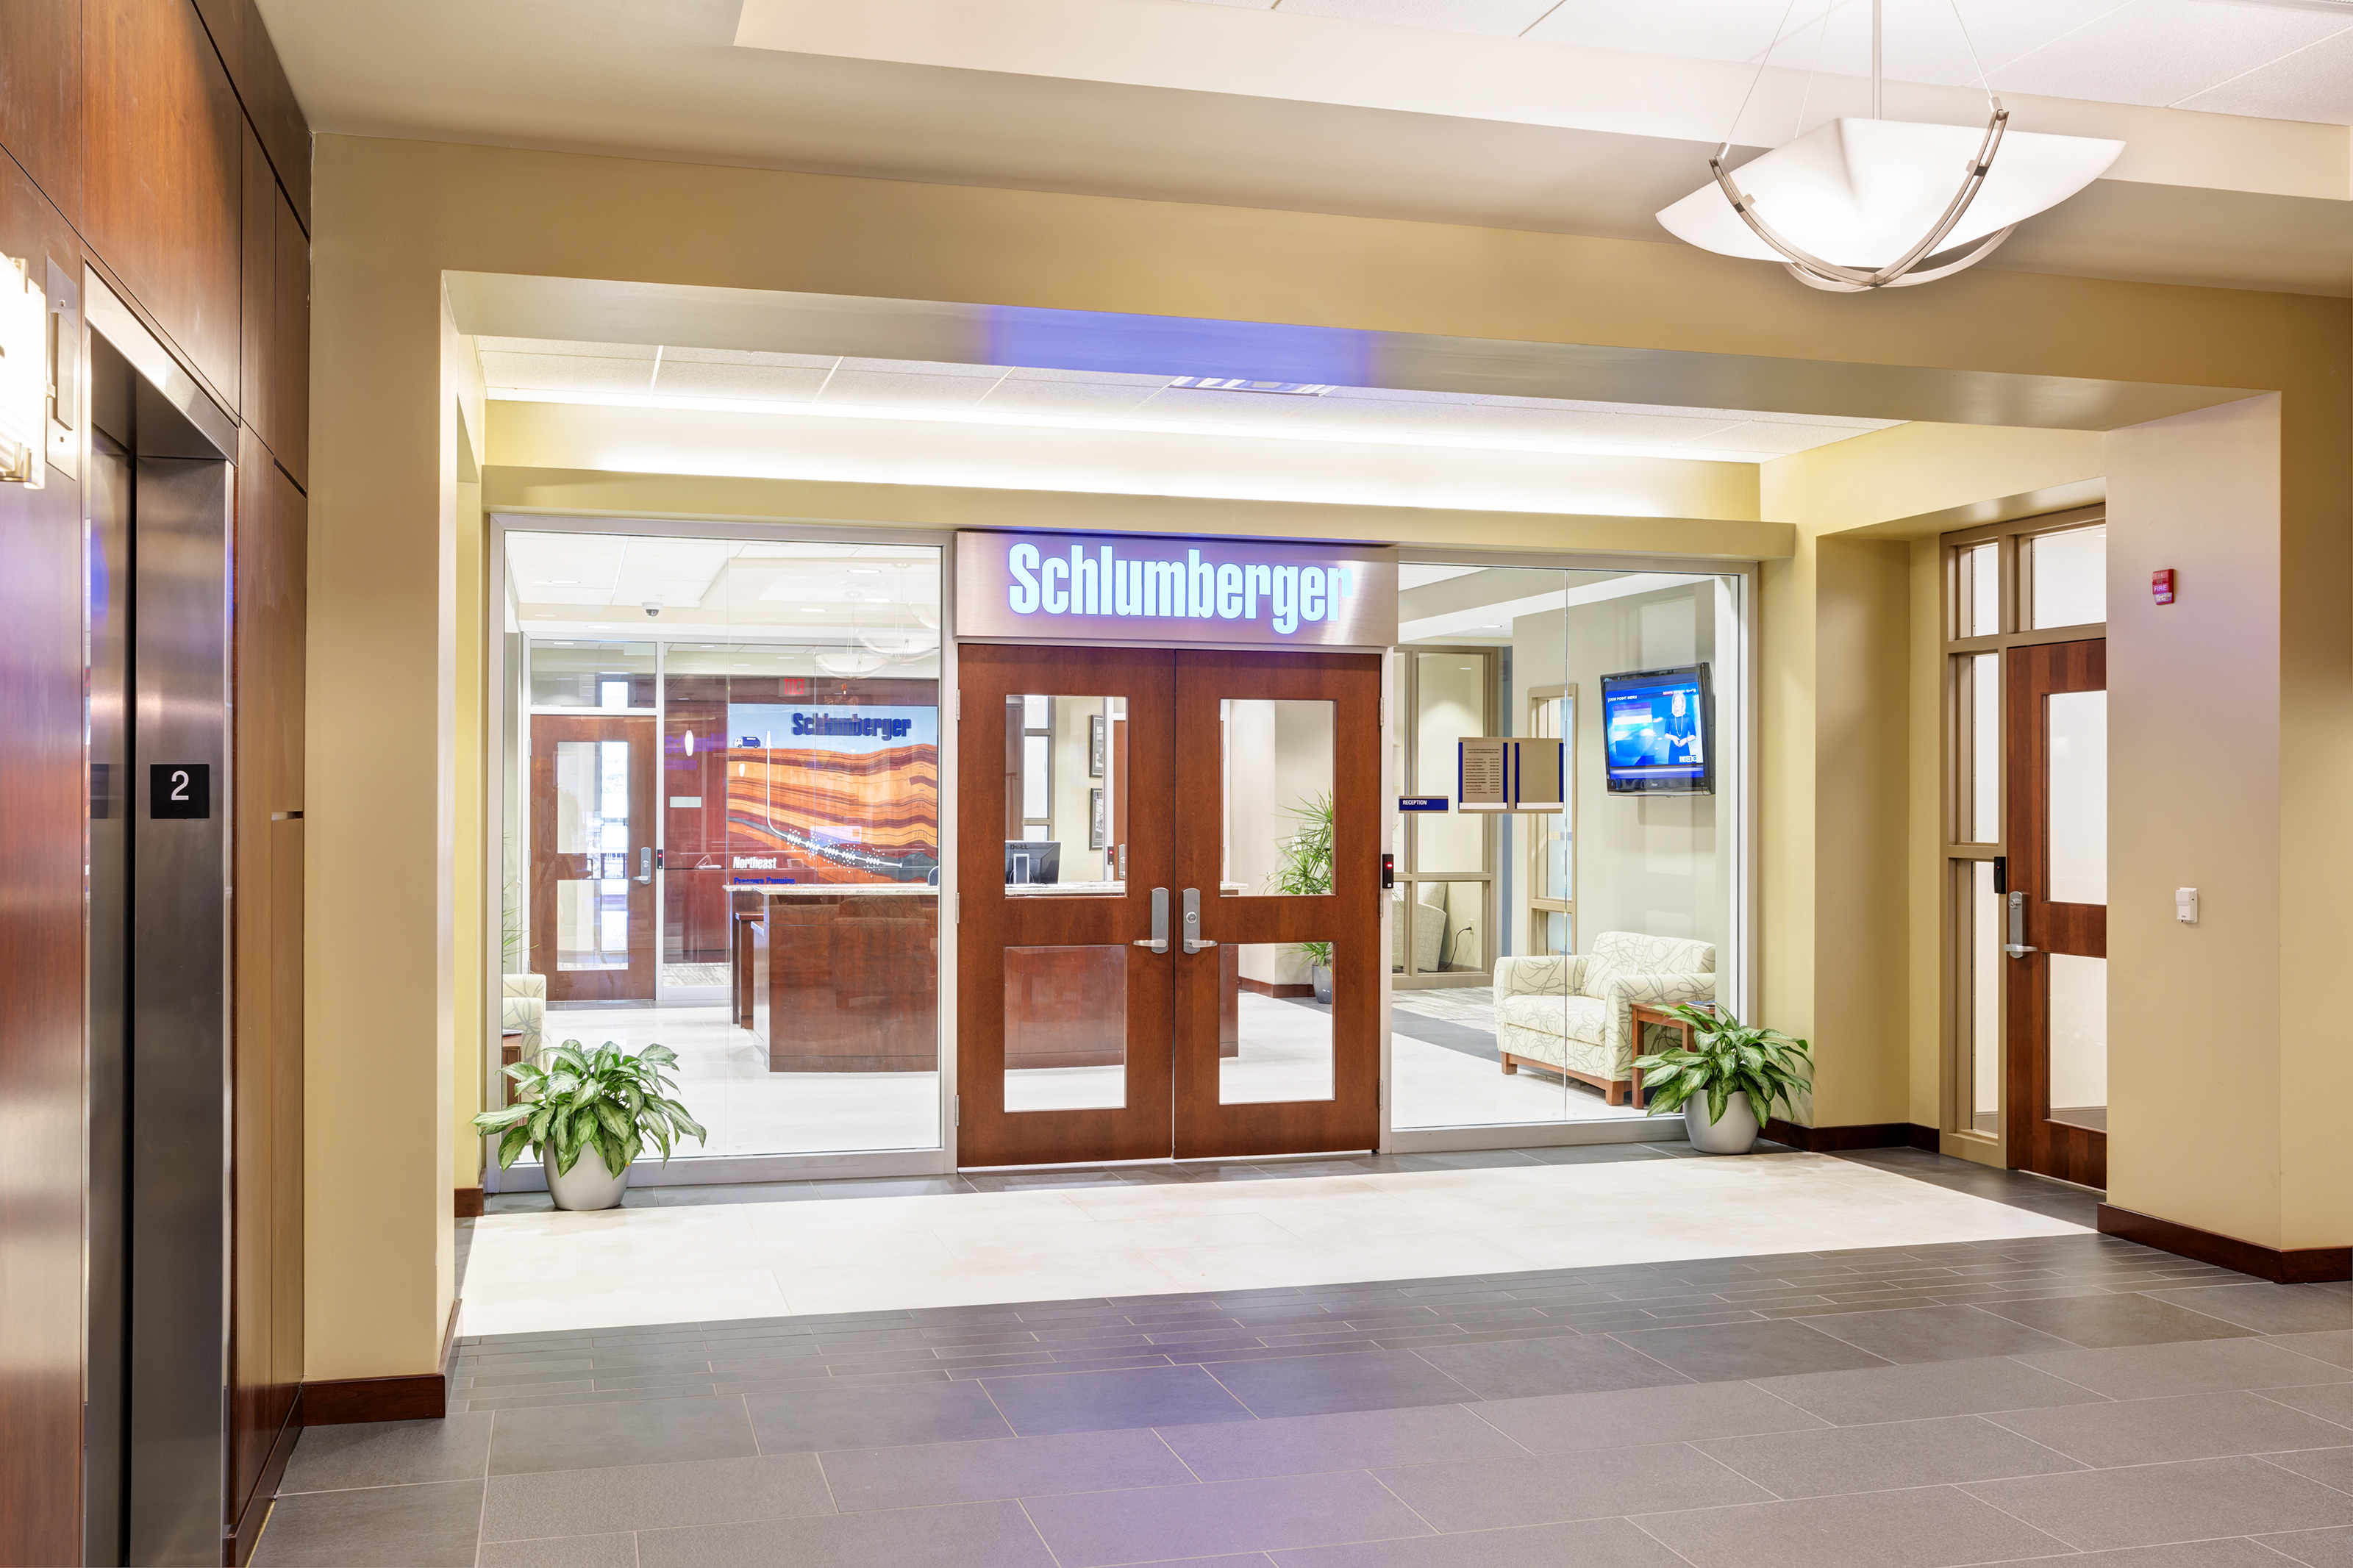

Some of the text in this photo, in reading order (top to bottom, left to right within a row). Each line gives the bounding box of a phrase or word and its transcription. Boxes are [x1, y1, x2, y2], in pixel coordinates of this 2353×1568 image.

[1008, 543, 1352, 634] Schlumberger
[791, 712, 912, 741] Schlumberger
[171, 770, 190, 801] 2
[732, 856, 777, 869] Northeast
[766, 876, 796, 885] Pumping
